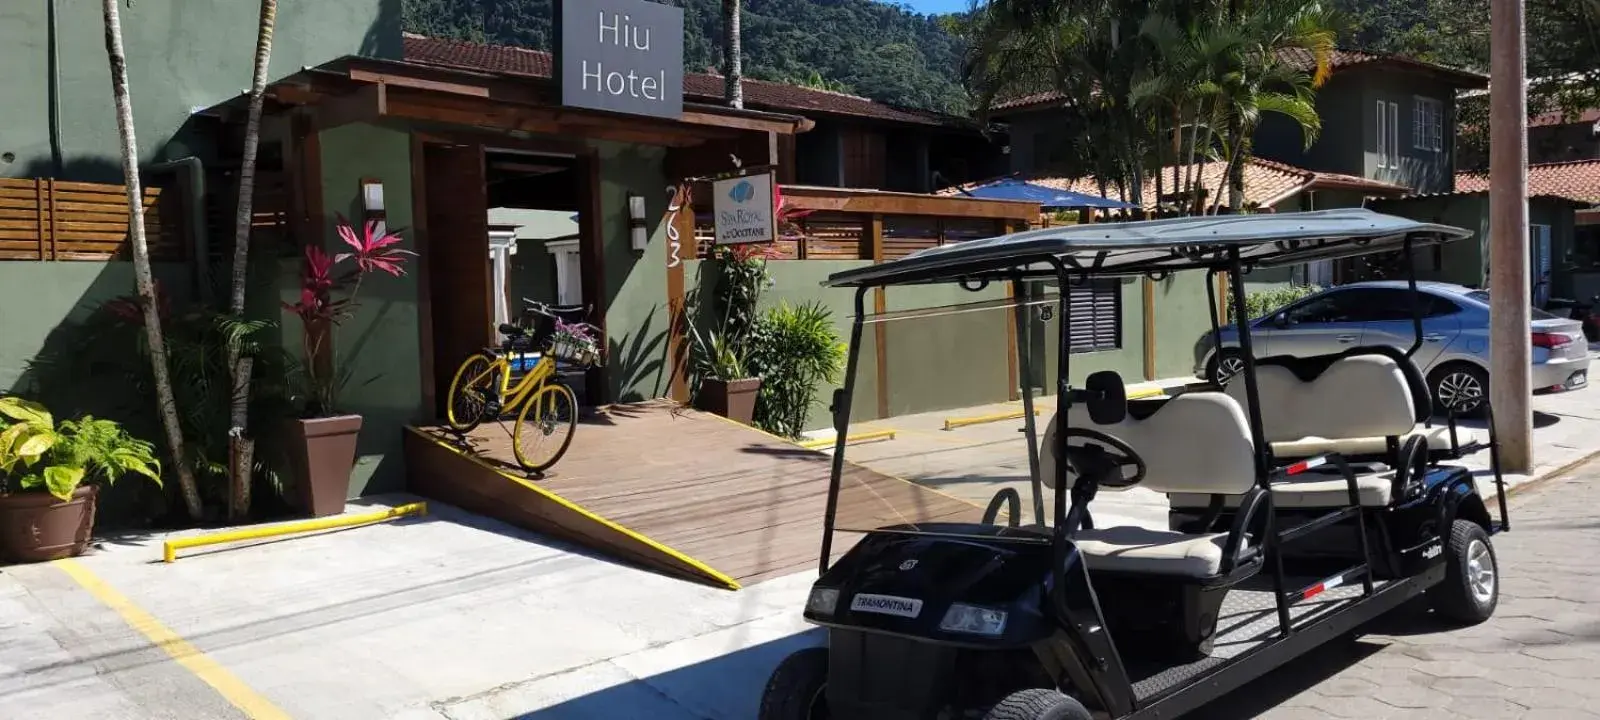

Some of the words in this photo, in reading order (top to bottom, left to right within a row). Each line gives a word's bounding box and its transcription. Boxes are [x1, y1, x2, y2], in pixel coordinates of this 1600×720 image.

[599, 11, 650, 51] Hiu
[582, 60, 665, 101] Hotel
[666, 185, 681, 268] 263
[857, 597, 914, 613] TRAMONTINA
